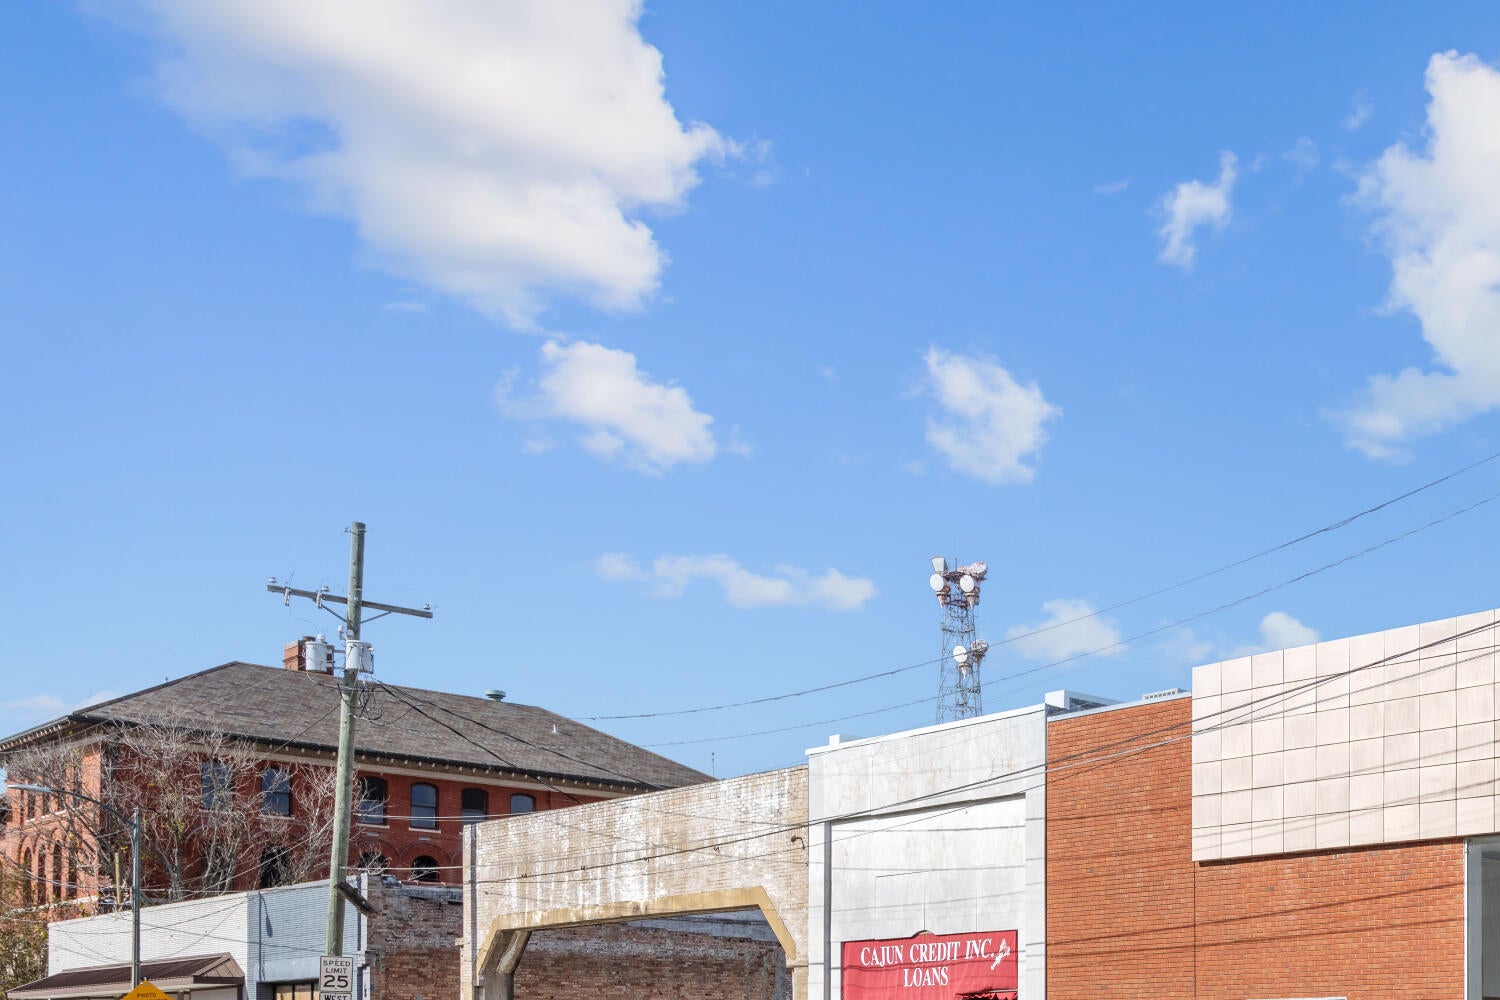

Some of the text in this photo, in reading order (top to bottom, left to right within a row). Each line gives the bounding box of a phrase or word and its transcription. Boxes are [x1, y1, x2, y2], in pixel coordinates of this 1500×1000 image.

[860, 938, 994, 967] CAJUN CREDIT INC.
[323, 974, 349, 988] 25
[903, 966, 949, 987] LOANS
